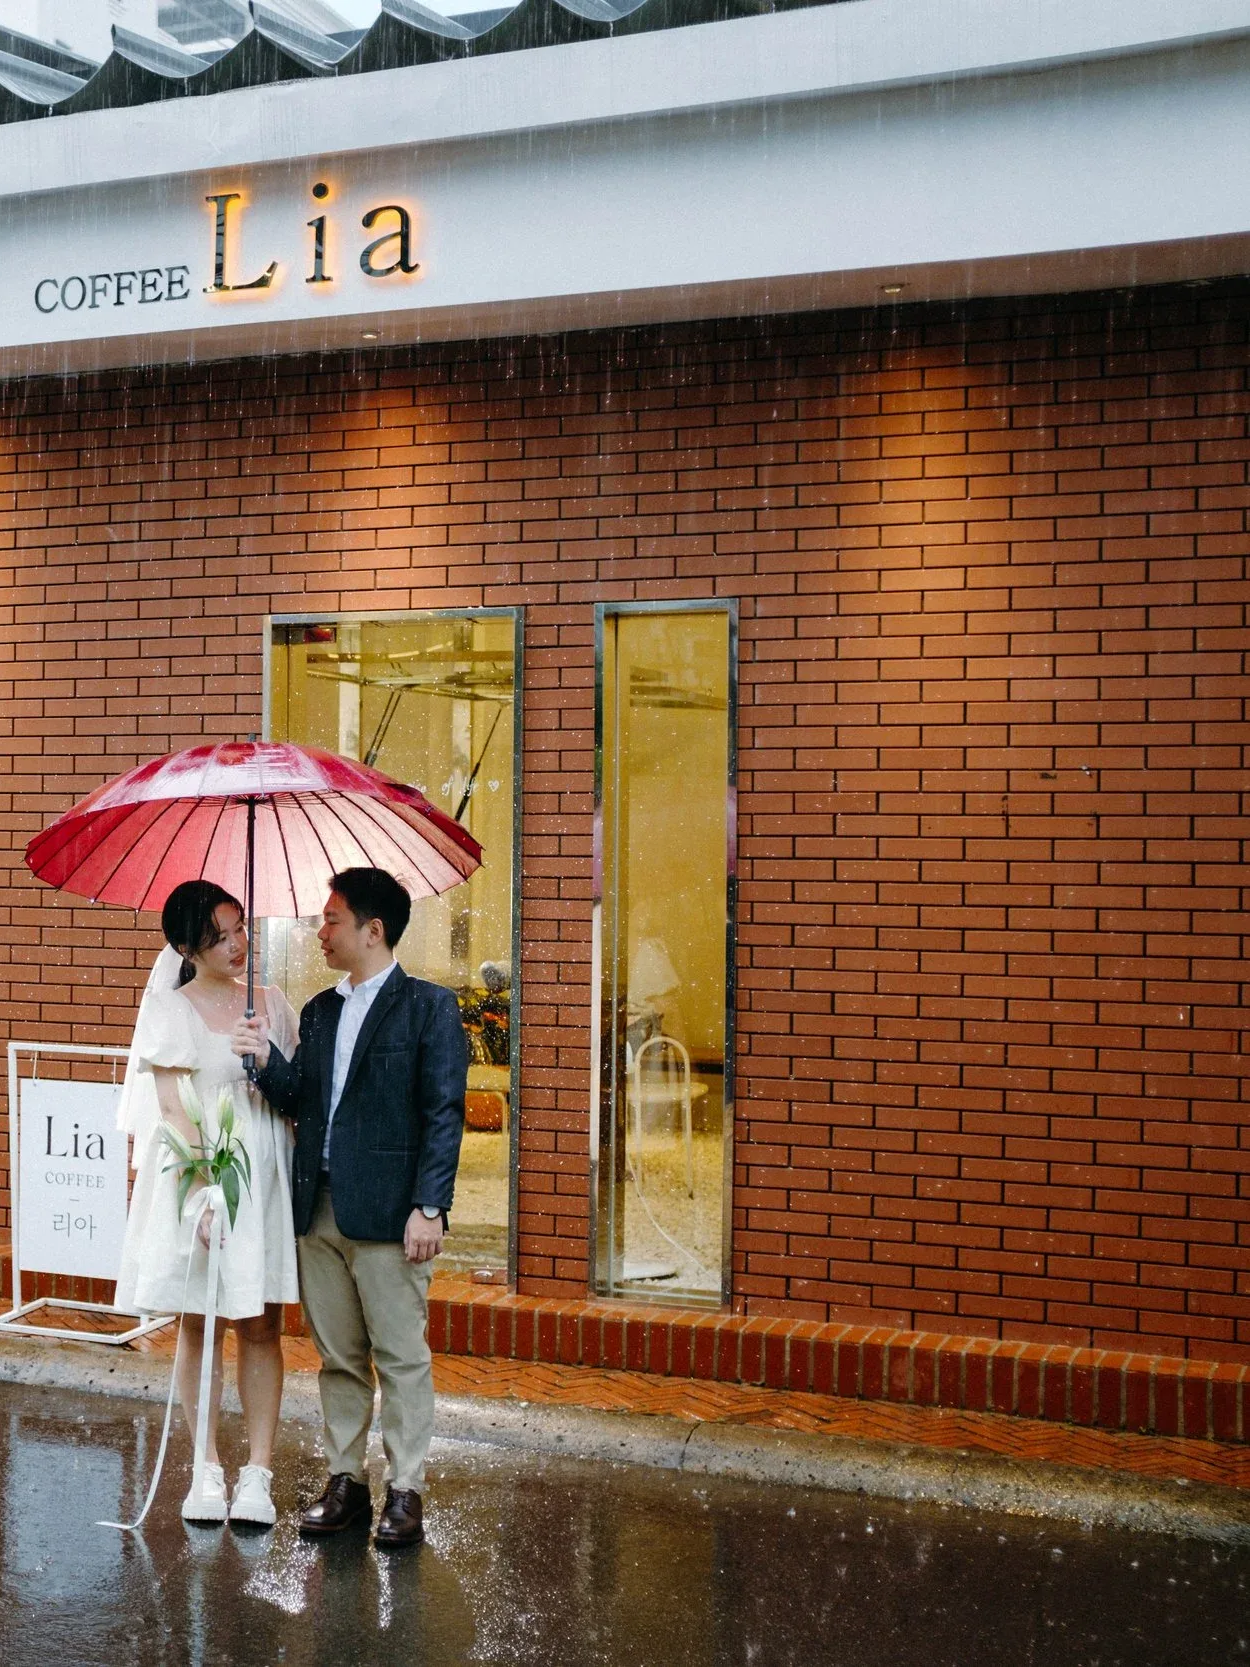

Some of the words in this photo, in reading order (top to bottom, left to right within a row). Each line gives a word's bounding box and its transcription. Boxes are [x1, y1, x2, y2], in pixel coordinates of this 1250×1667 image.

[35, 266, 190, 313] COFFEE
[203, 183, 419, 293] Lia
[45, 1115, 105, 1160] Lia
[45, 1171, 105, 1189] COFFEE
[53, 1212, 97, 1240] 리아
